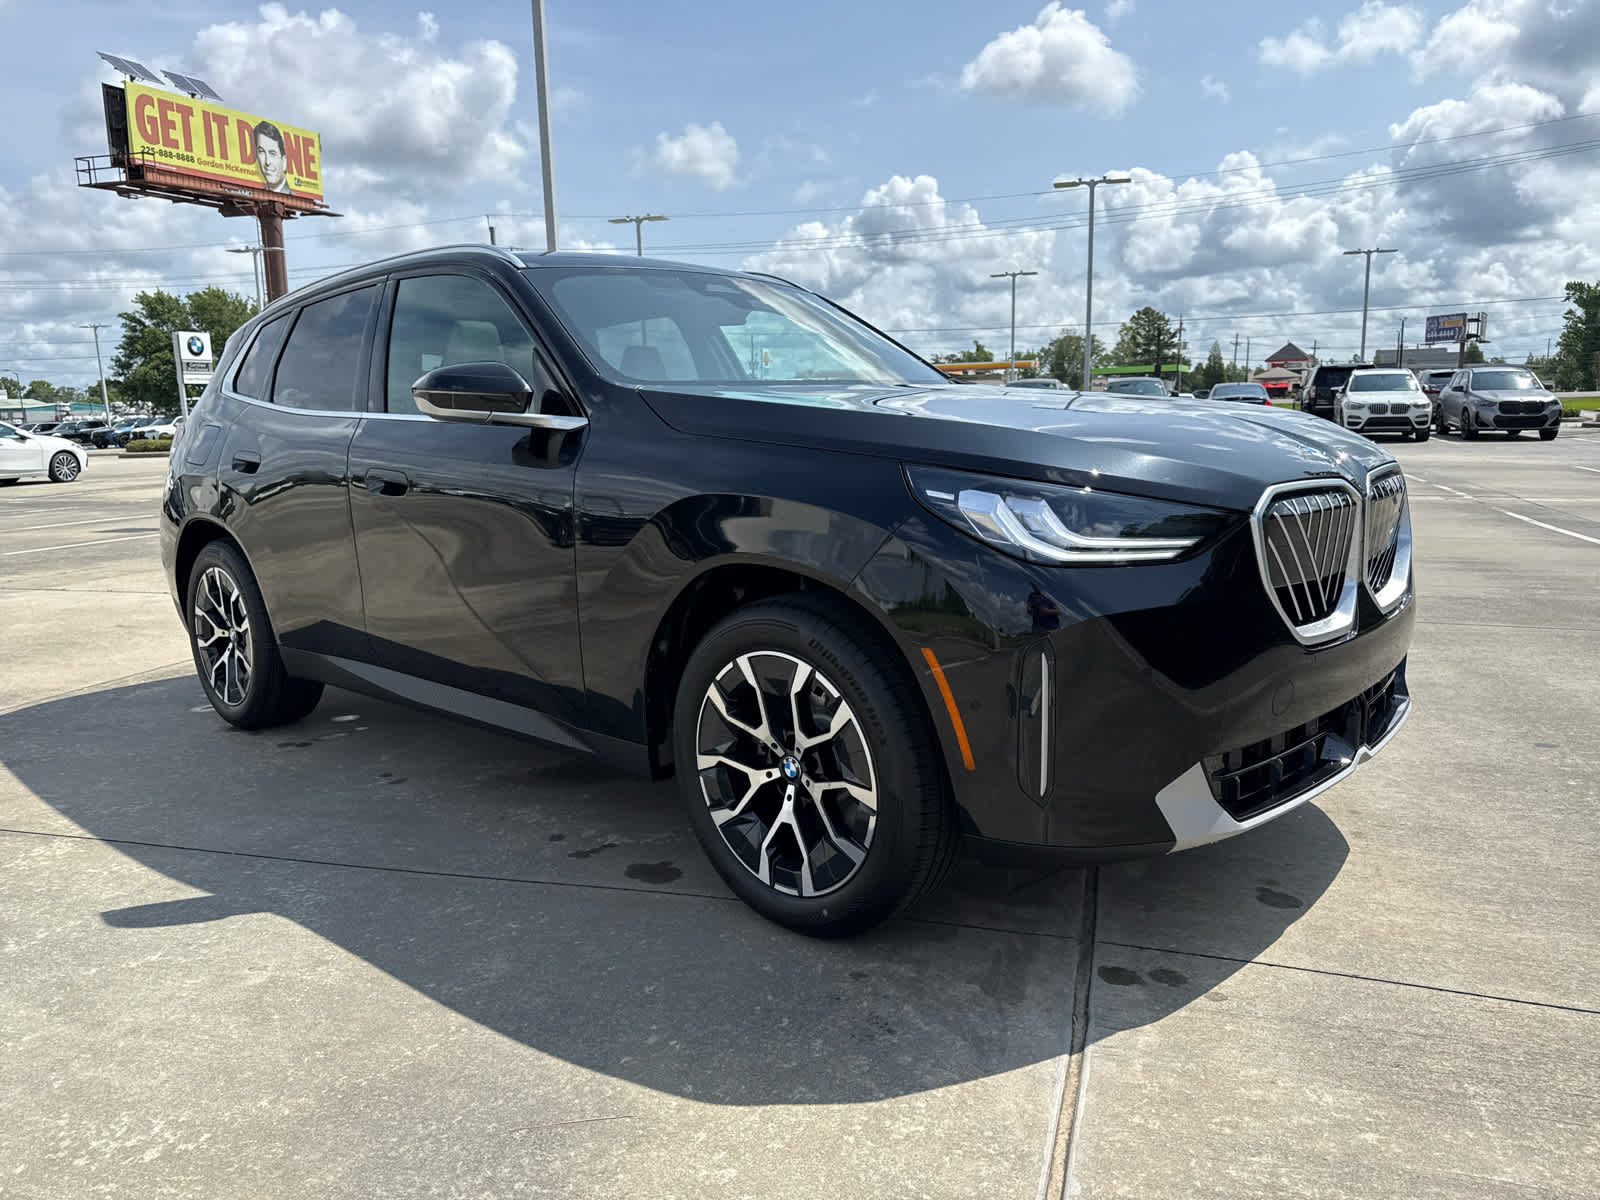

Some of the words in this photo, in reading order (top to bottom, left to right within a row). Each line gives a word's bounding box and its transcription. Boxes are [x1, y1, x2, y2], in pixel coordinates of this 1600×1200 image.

[134, 94, 194, 152] GET
[202, 110, 229, 160] IT
[236, 118, 318, 179] DNE
[140, 145, 196, 164] 225-888-8888
[196, 157, 225, 170] Gordon
